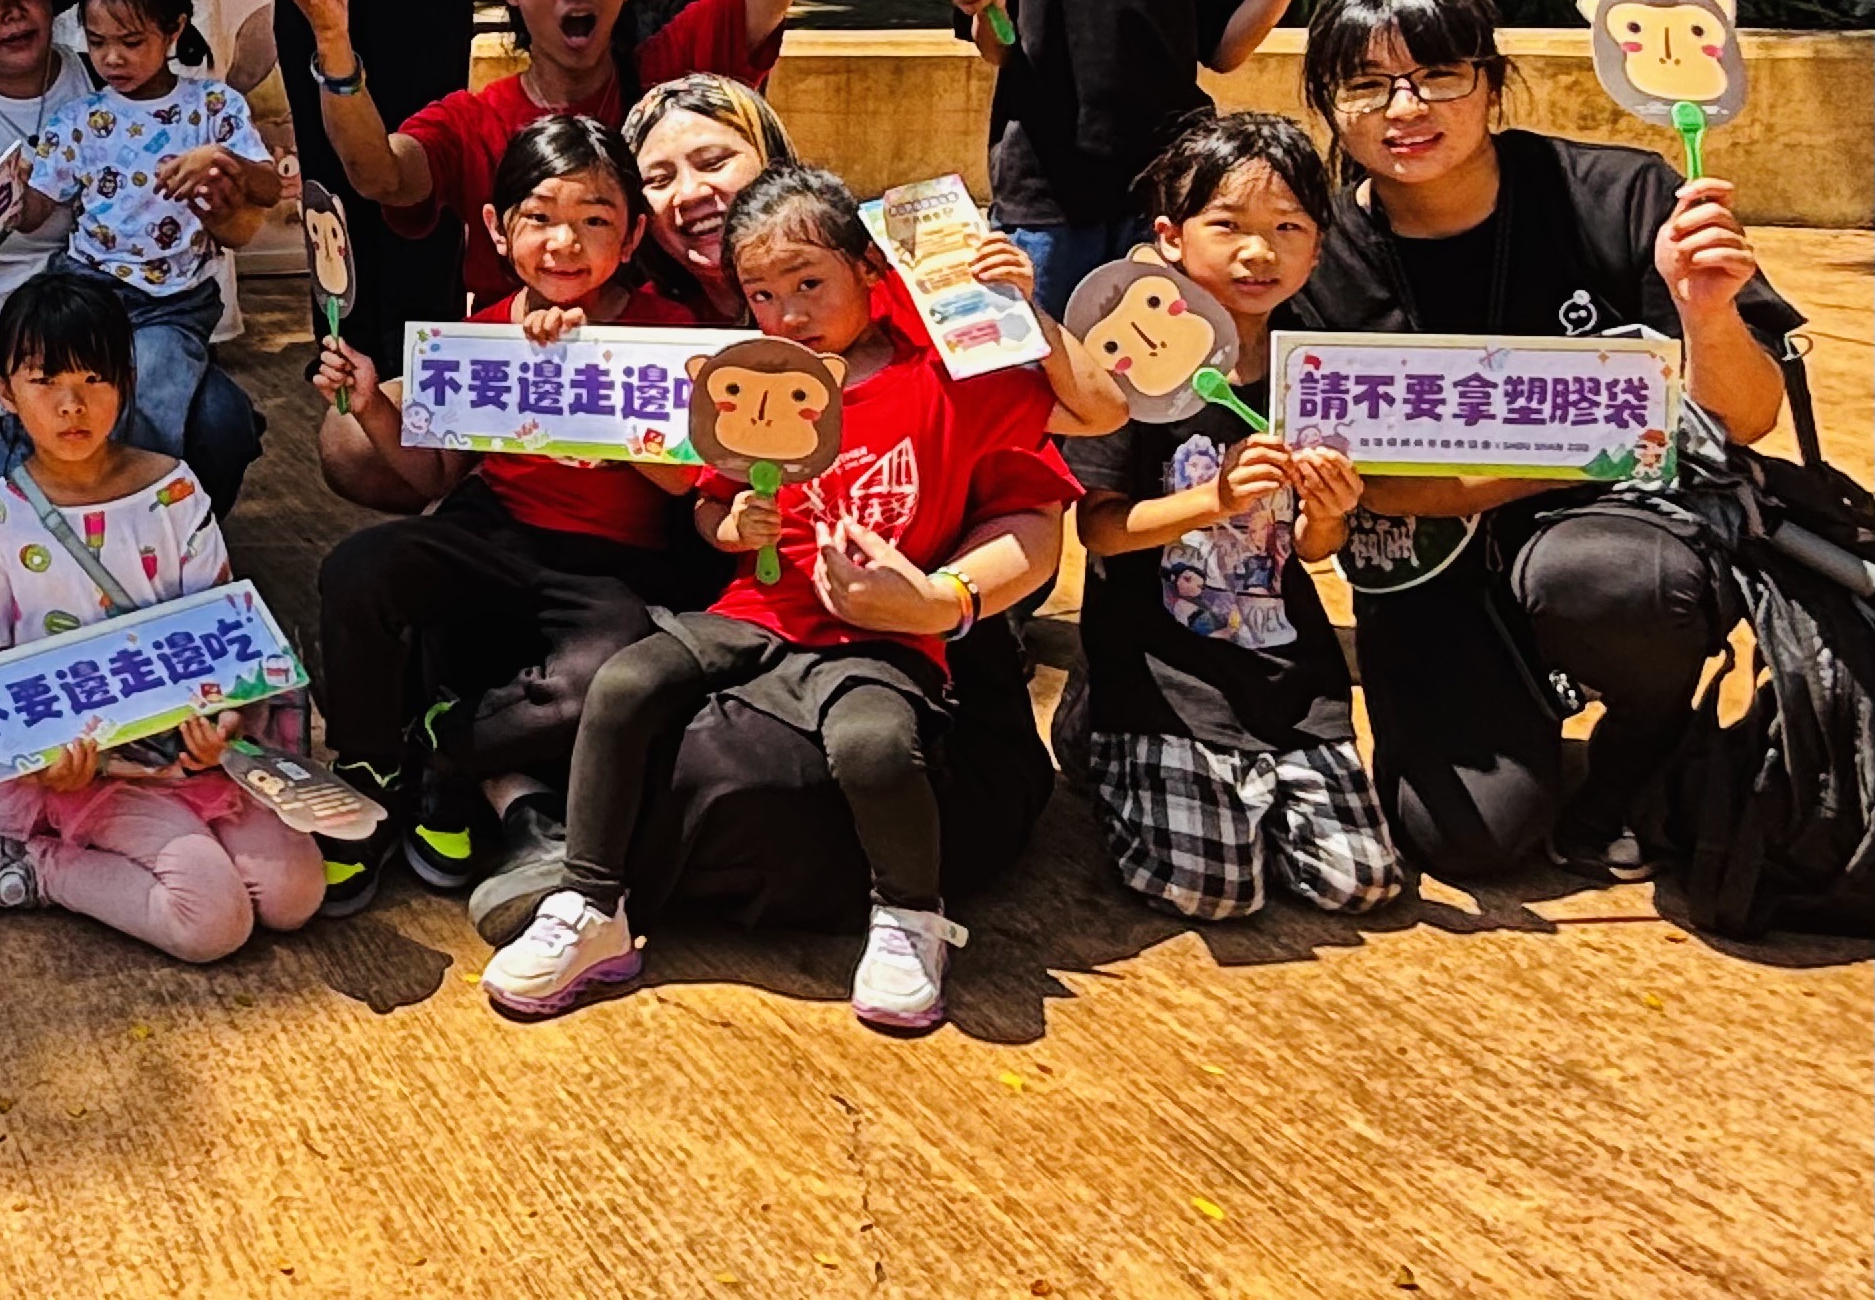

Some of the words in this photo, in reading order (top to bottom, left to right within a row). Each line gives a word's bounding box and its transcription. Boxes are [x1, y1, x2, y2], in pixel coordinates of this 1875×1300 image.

[1298, 371, 1651, 430] 請不要拿塑膠袋
